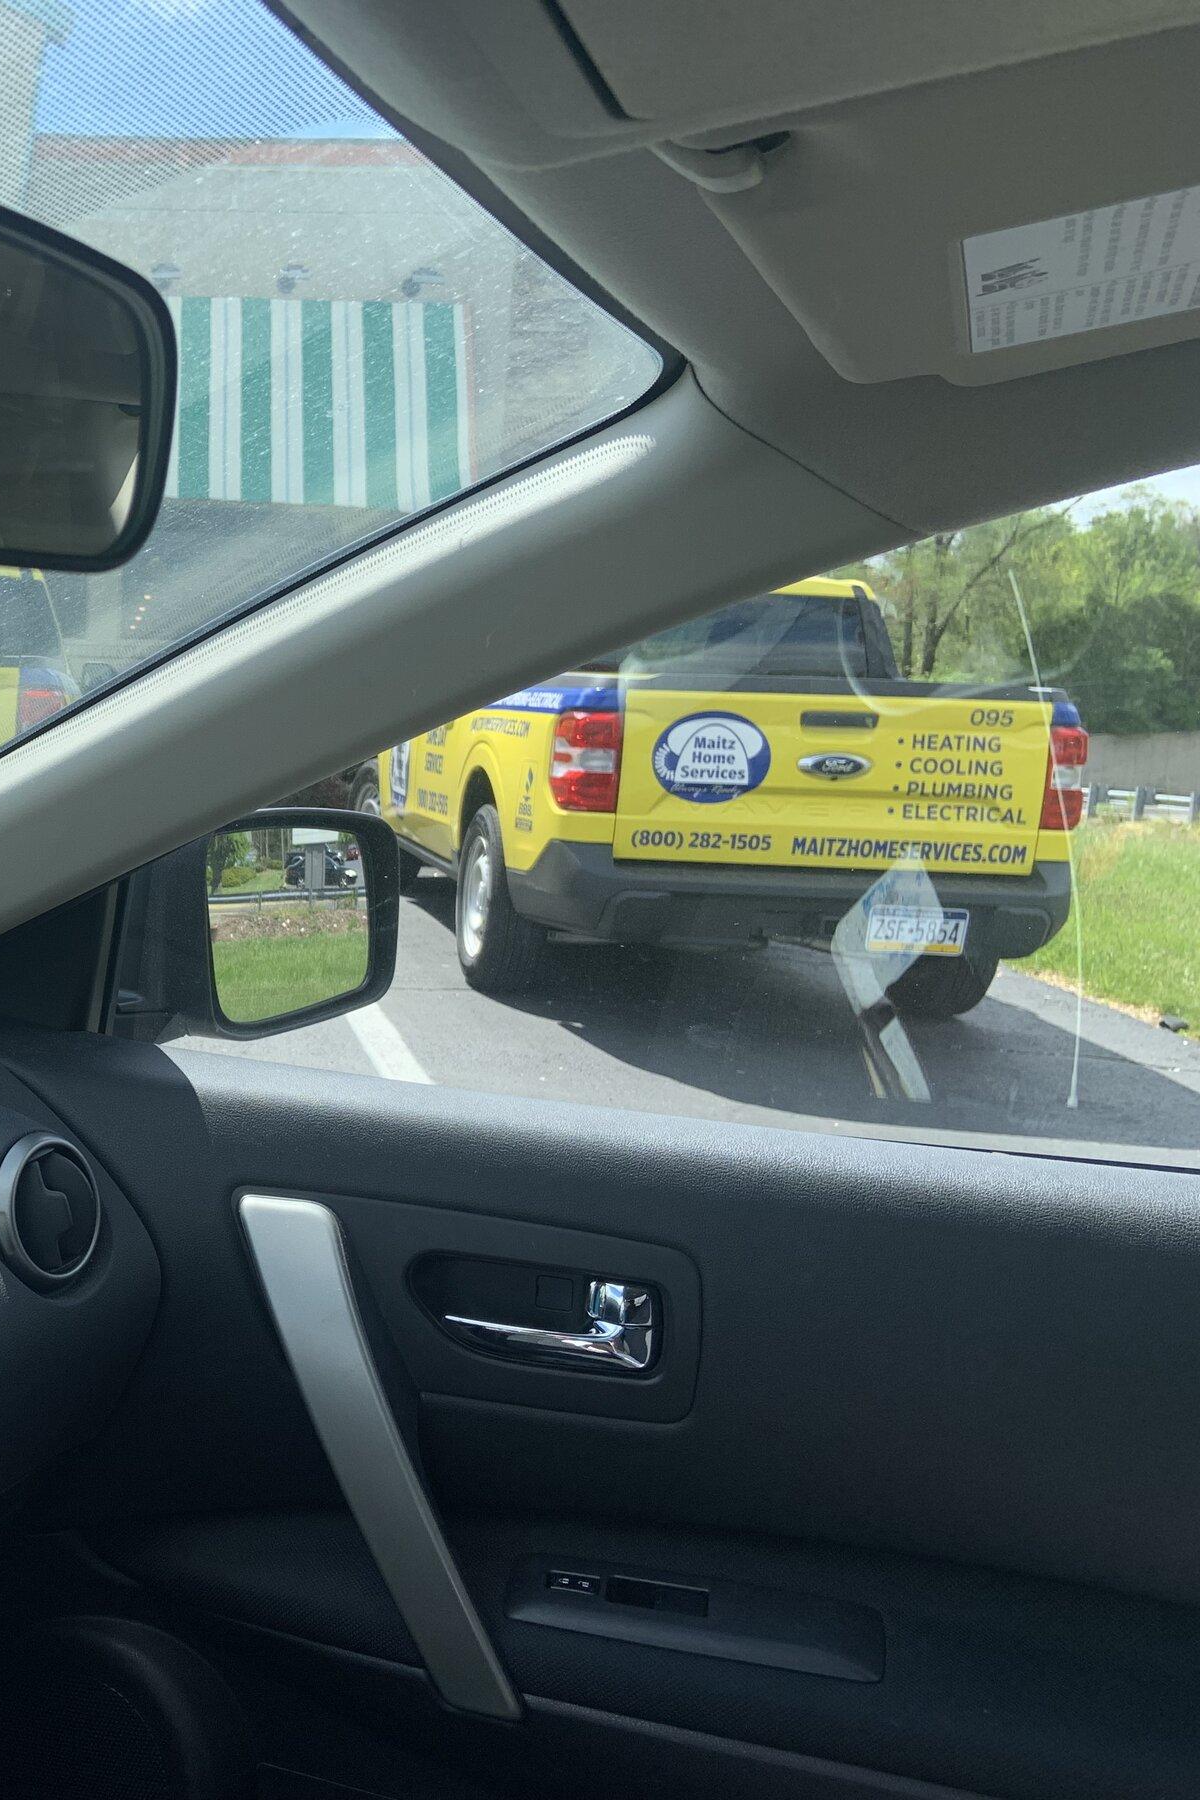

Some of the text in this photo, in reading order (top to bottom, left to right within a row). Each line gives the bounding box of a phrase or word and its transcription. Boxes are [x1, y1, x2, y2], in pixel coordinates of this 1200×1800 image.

[970, 709, 1014, 727] 095
[694, 735, 736, 750] Maitz
[911, 733, 1002, 753] HEATING
[692, 752, 736, 765] Home
[909, 757, 1003, 776] COOLING
[680, 766, 745, 780] Services
[906, 781, 1013, 800] PLUMBING
[902, 803, 1026, 825] ELECTRICAL
[631, 830, 772, 851] (800) 282-1505
[791, 836, 1027, 864] MAITZHOMESERVICES.COM
